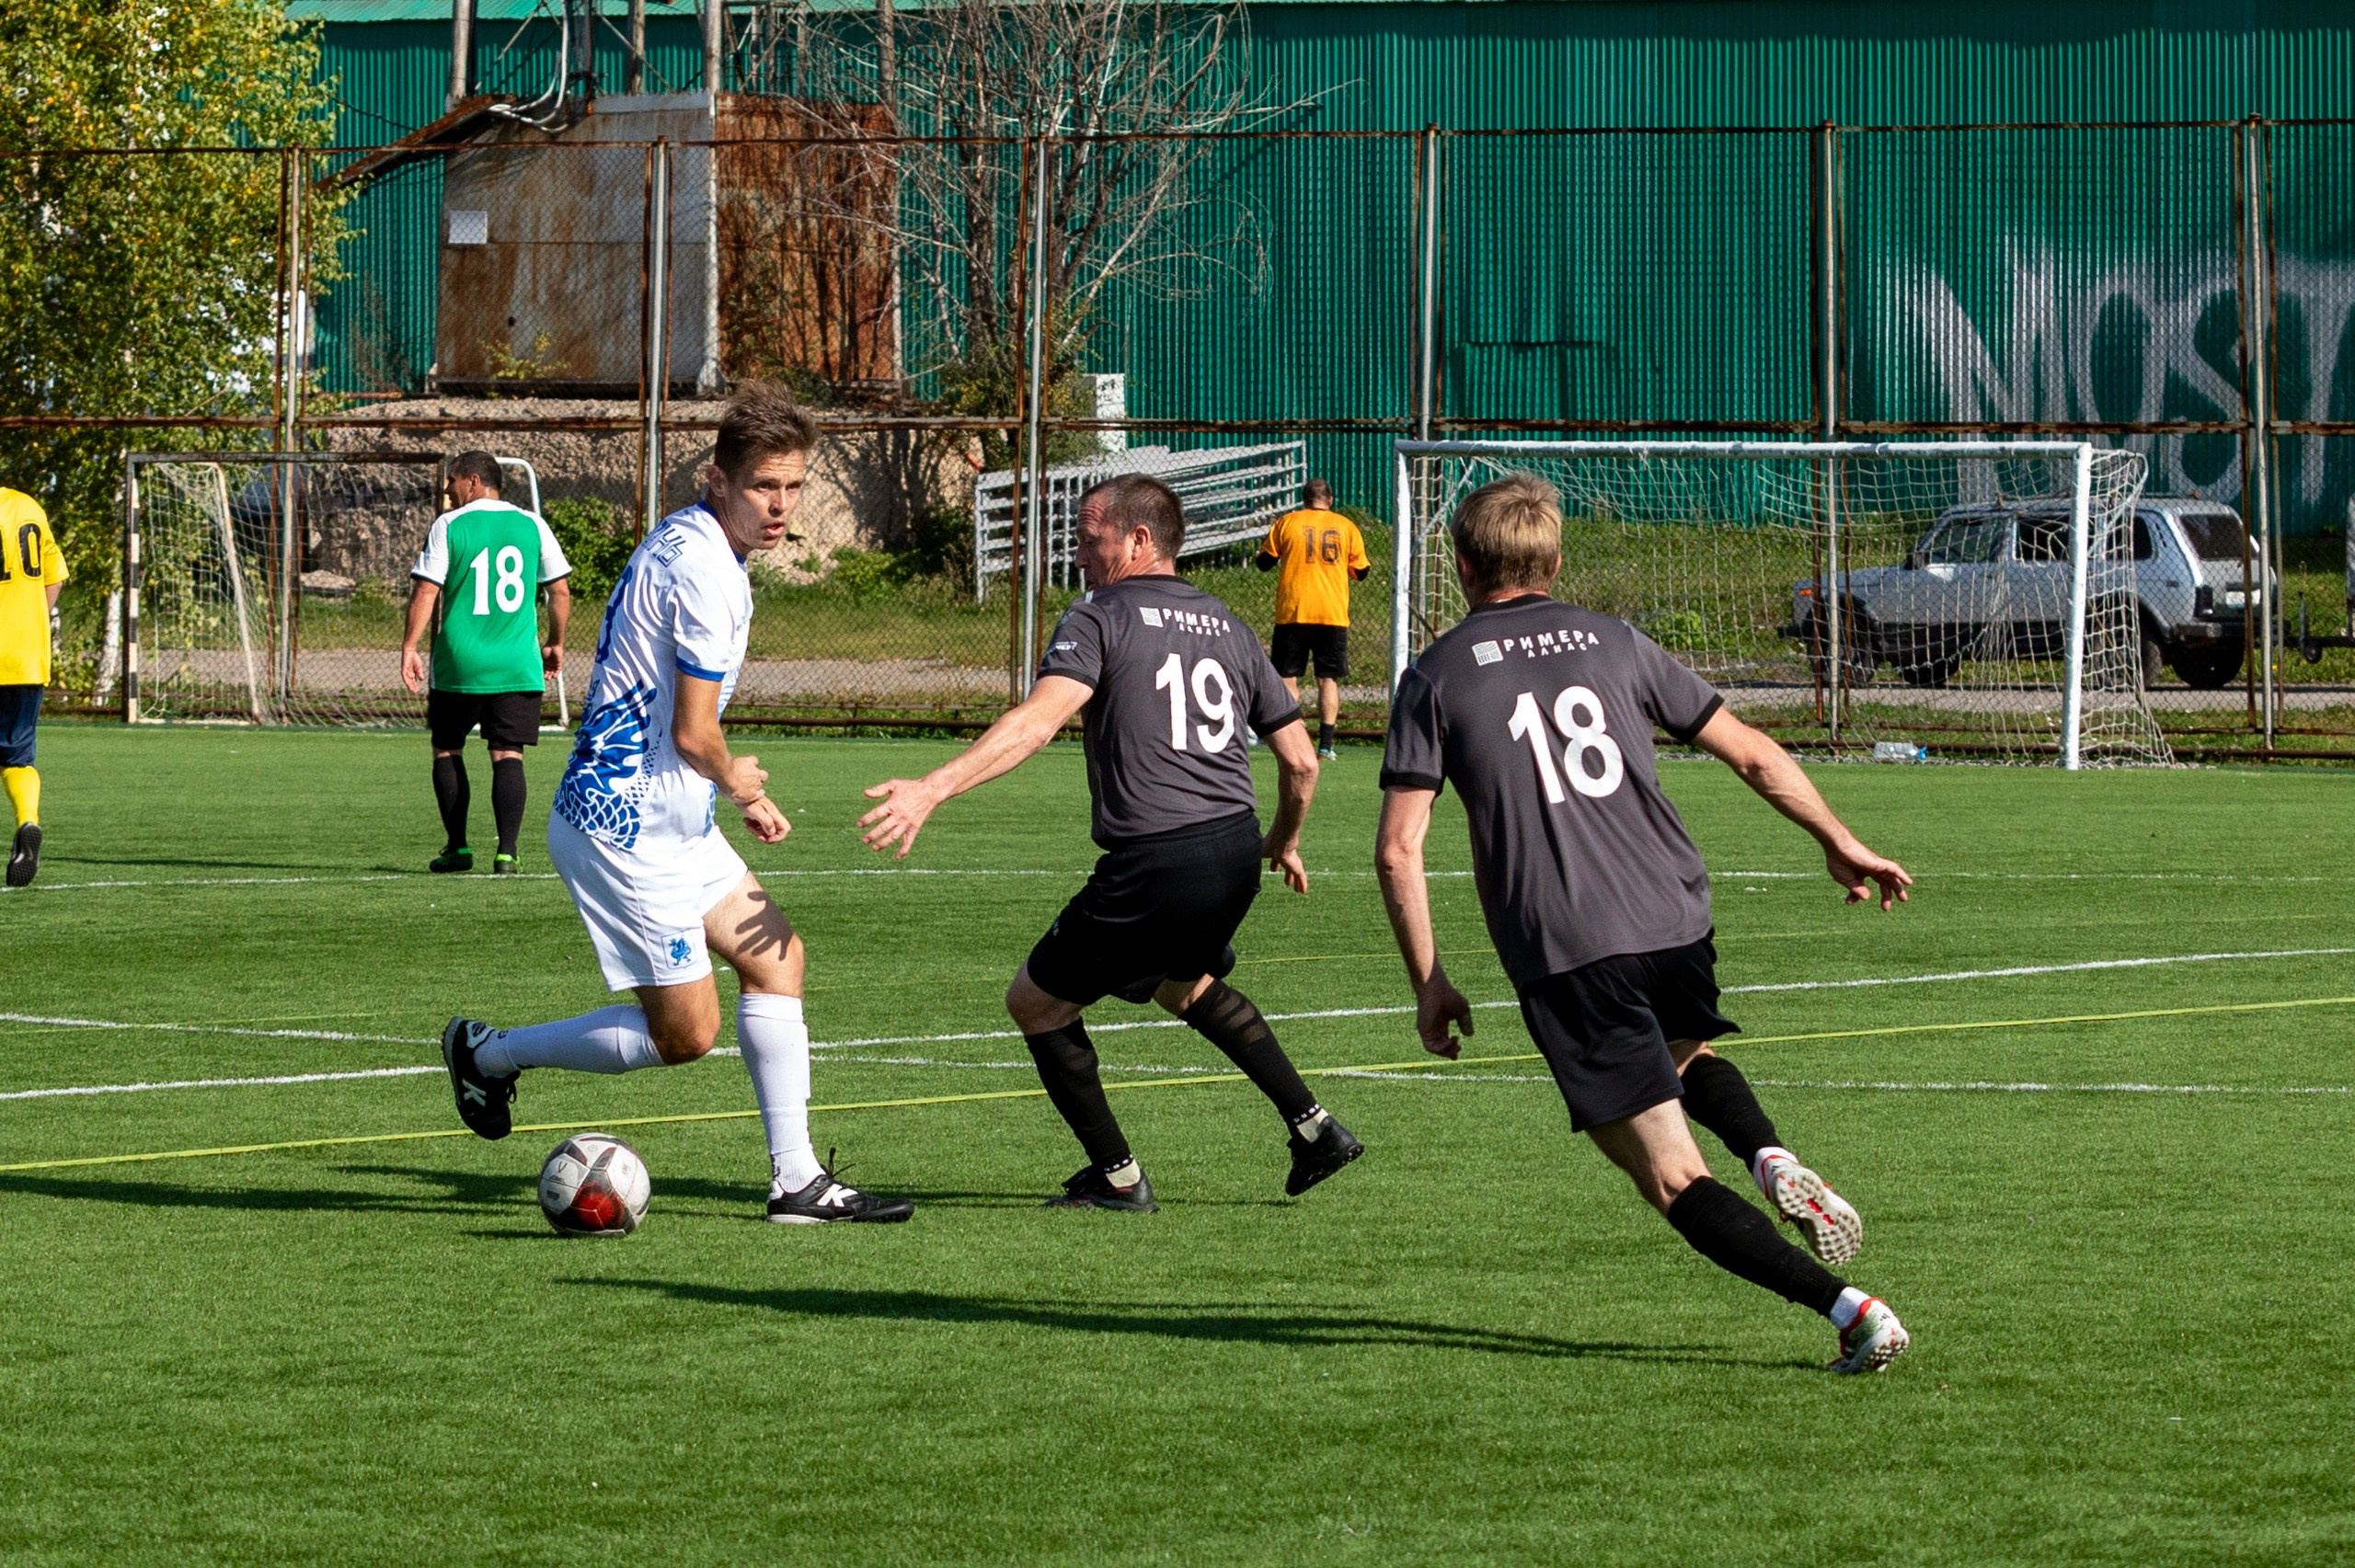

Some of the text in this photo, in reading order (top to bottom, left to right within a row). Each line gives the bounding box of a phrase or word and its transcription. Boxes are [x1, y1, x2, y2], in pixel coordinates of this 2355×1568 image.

[1303, 526, 1341, 565] 16
[470, 545, 525, 616] 18
[1162, 608, 1231, 633] РИМЕРА
[1502, 629, 1600, 652] РИМЕРА
[1527, 642, 1588, 658] АЛНАС
[1155, 652, 1235, 754] 19
[1507, 685, 1624, 804] 18
